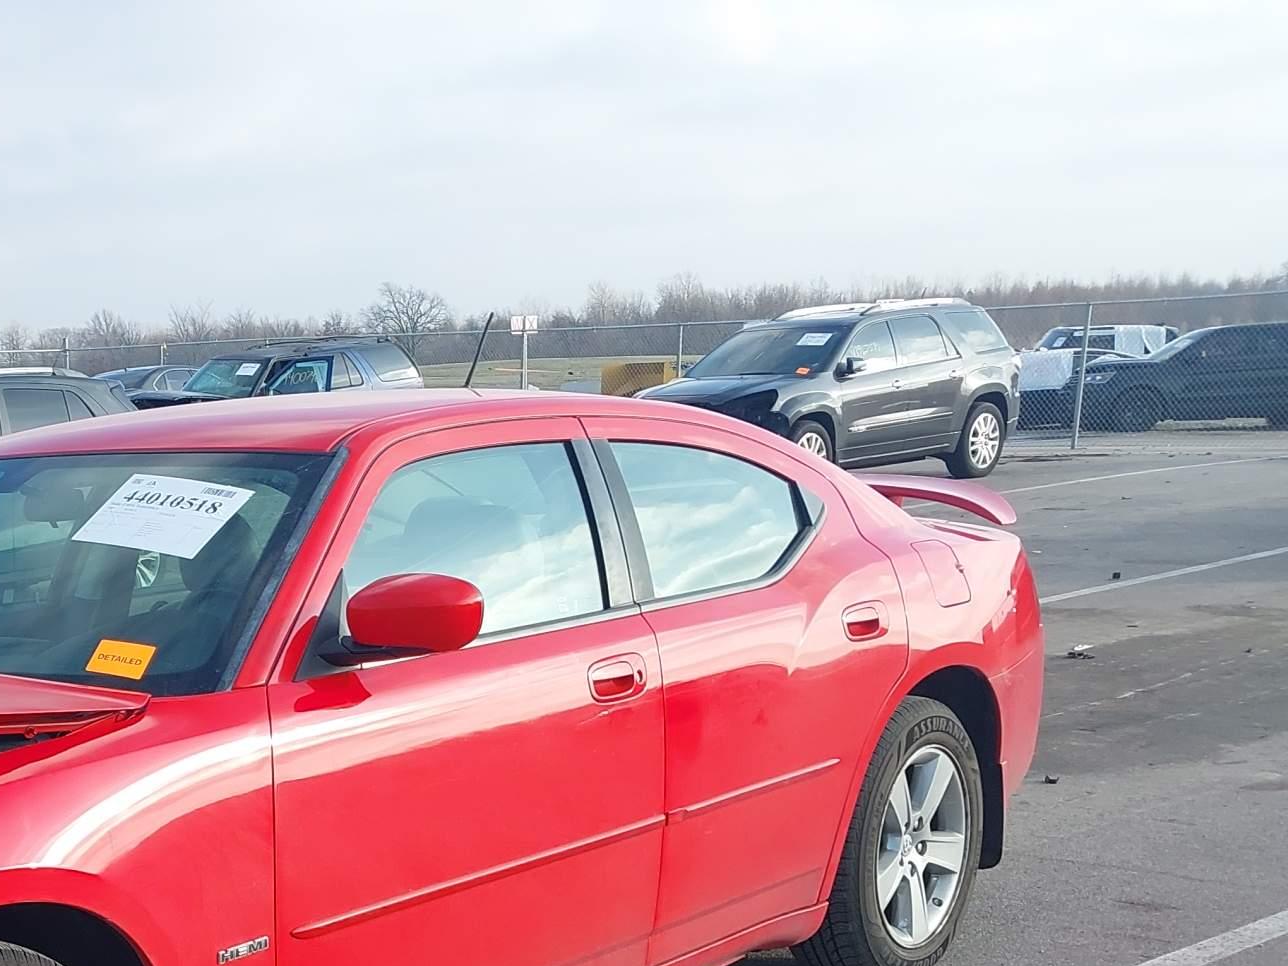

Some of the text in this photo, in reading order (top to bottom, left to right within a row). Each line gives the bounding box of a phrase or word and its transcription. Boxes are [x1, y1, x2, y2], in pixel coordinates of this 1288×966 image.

[123, 490, 223, 515] 44010518
[97, 653, 143, 666] DETAILED
[218, 936, 270, 965] HEMI
